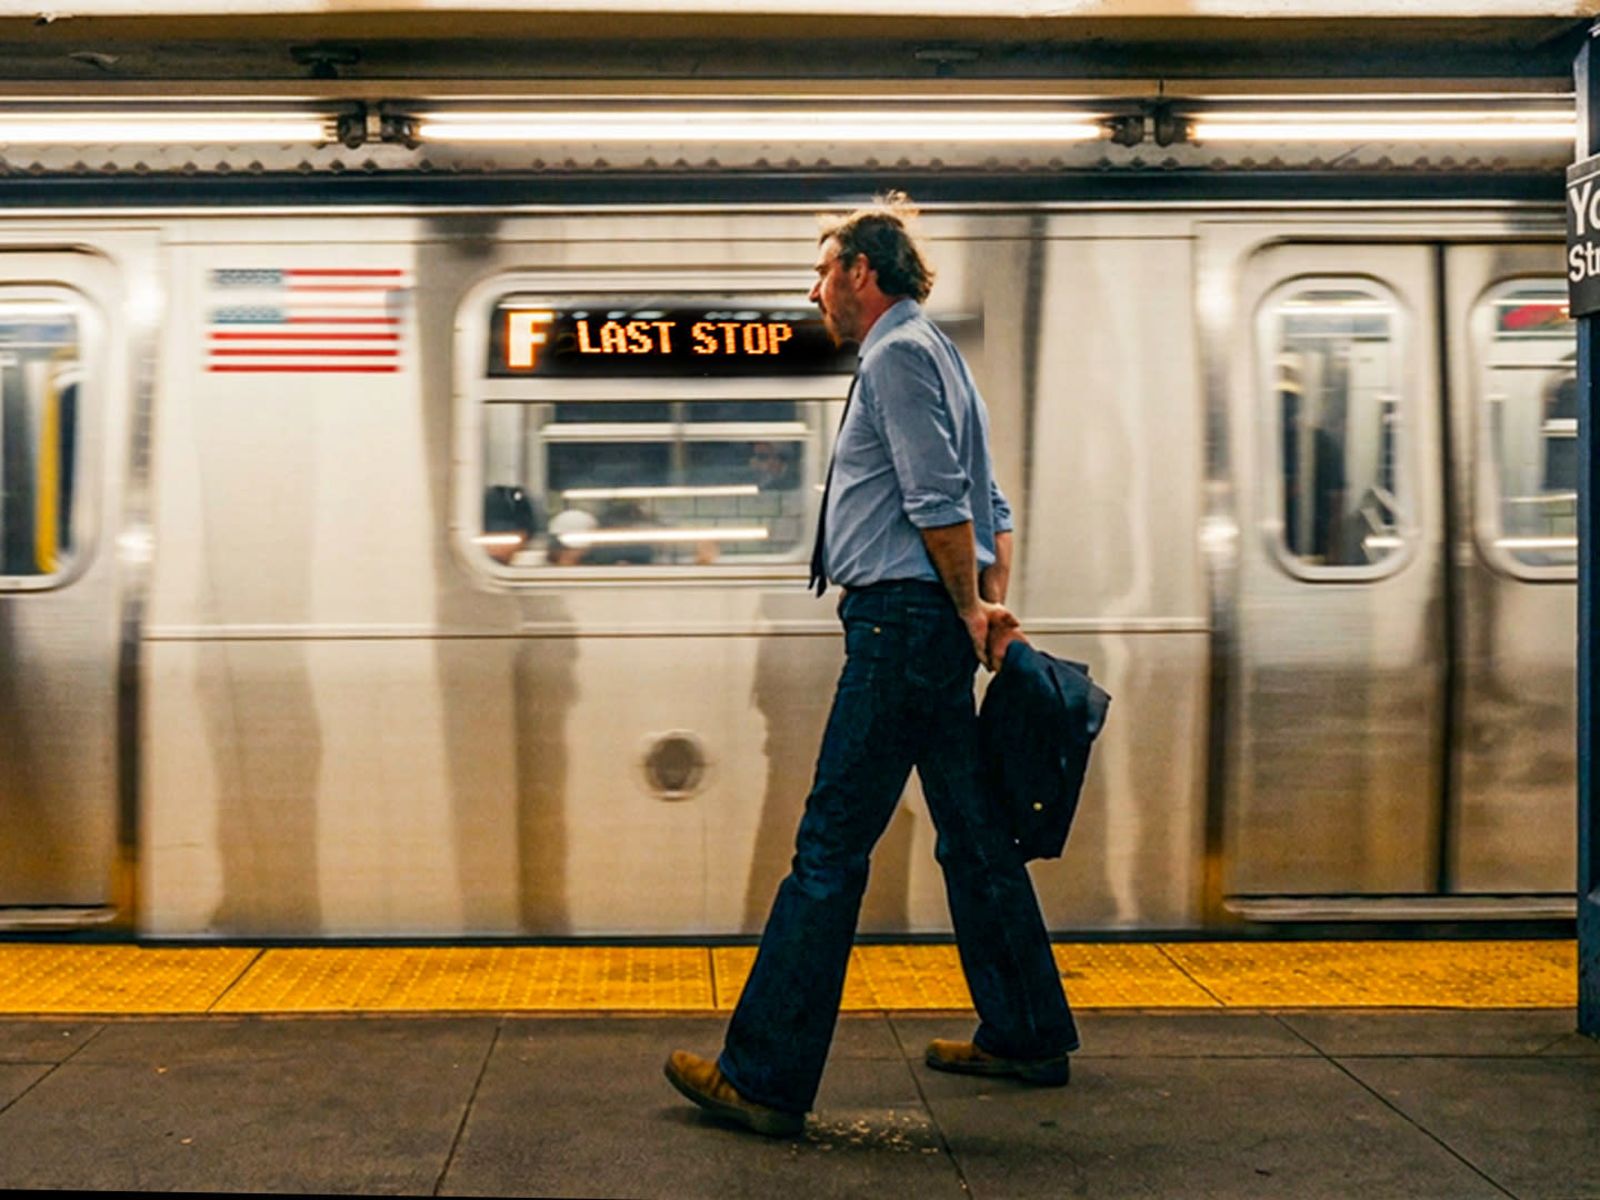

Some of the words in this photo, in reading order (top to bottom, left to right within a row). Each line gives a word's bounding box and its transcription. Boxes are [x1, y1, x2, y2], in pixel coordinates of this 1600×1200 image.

[507, 310, 555, 368] F
[577, 321, 675, 353] LAST
[691, 322, 792, 354] STOP
